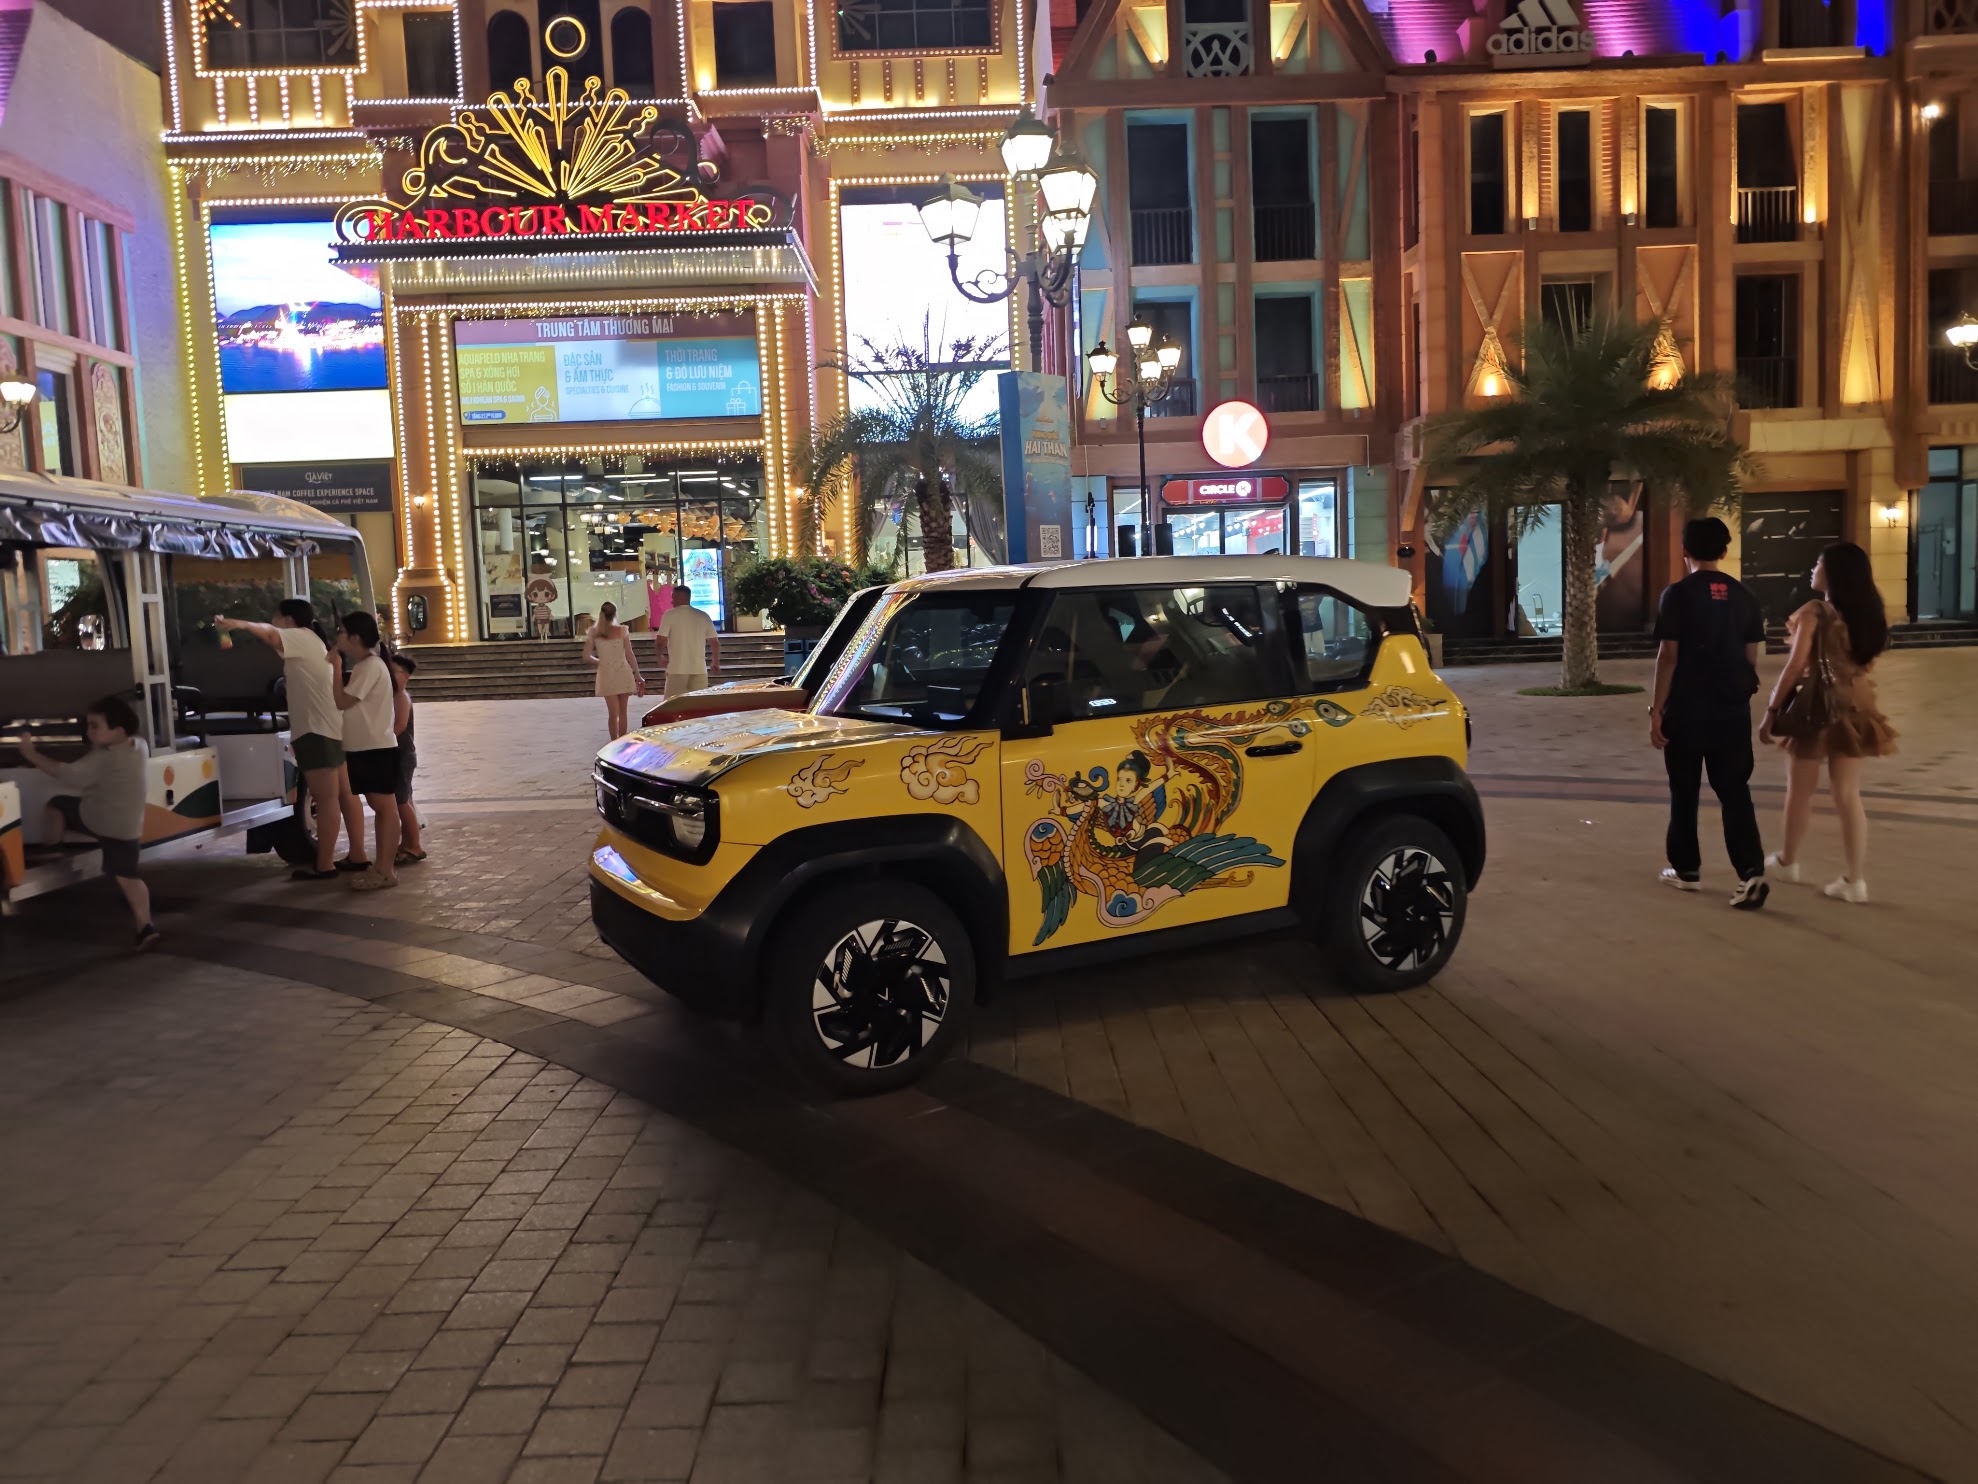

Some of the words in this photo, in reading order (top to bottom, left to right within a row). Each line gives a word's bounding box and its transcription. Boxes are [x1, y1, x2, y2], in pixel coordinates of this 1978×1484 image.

[1486, 26, 1595, 55] adidas
[364, 206, 568, 240] HARBOUR
[577, 199, 755, 233] MARKET
[535, 321, 575, 338] TRUNG
[576, 319, 600, 336] TÂM
[459, 352, 500, 365] AQUAFIELD
[501, 351, 519, 363] NHA
[519, 350, 546, 363] TRANG
[584, 350, 602, 366] SẢN
[687, 348, 718, 362] TRANG
[460, 367, 475, 379] SPA
[483, 365, 505, 379] XÔNG
[565, 370, 572, 383] &
[589, 368, 614, 384] THỰC
[666, 366, 673, 380] &
[666, 382, 692, 392] FASHION
[697, 381, 727, 391] SOUVENIR
[1219, 414, 1262, 462] K
[292, 488, 315, 498] COFFEE
[316, 487, 353, 497] EXPERIENCE
[354, 486, 375, 496] SPACE
[1199, 484, 1236, 495] CIRCLE
